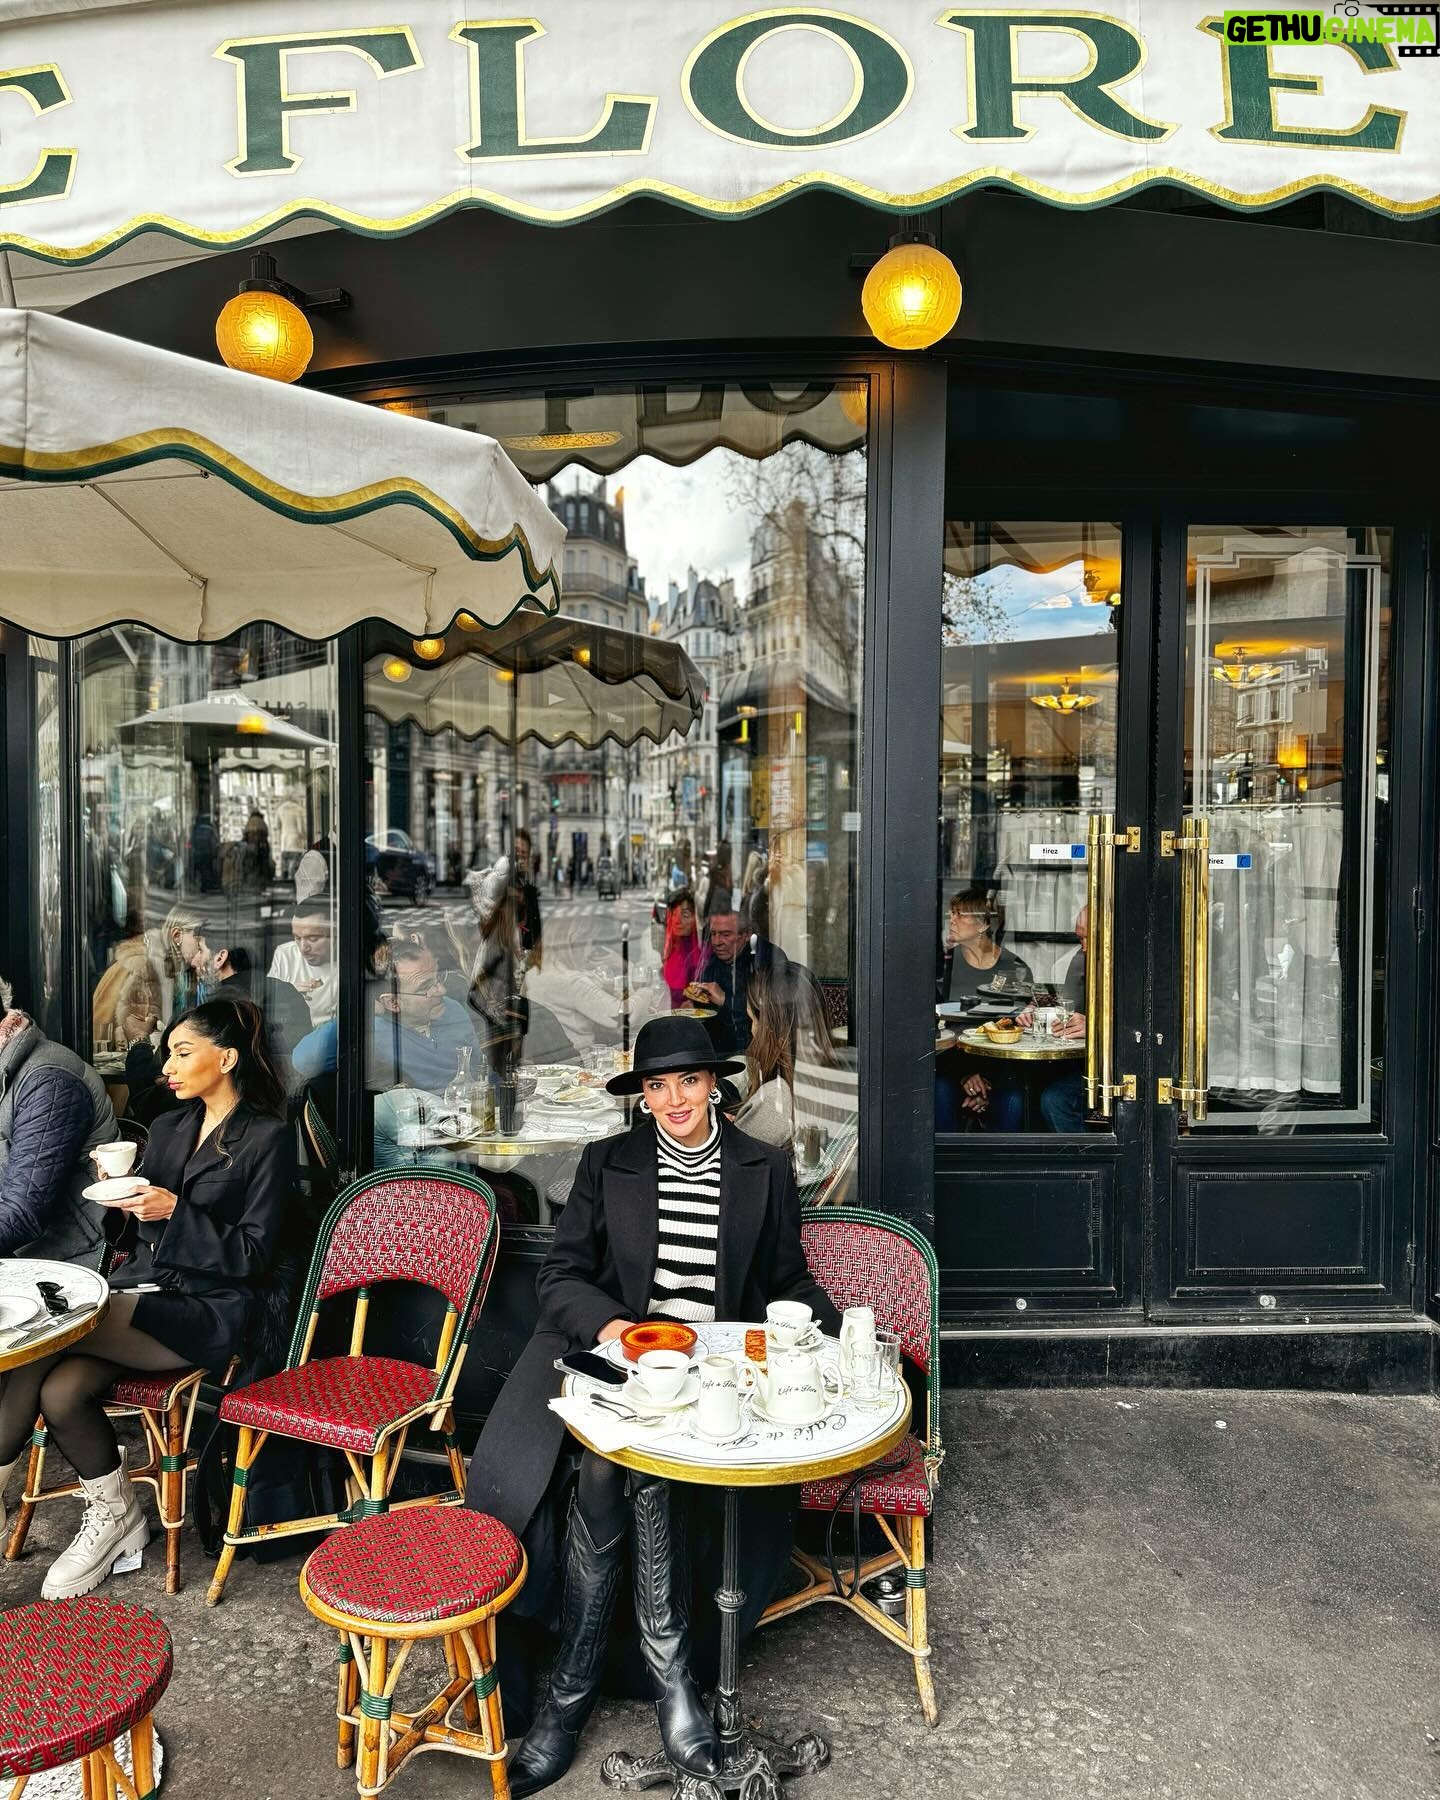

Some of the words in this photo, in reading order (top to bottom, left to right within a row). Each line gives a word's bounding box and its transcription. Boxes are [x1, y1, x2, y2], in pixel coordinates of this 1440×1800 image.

[212, 7, 1408, 178] FLORE
[1042, 847, 1059, 855] tirez
[766, 1431, 784, 1441] de
